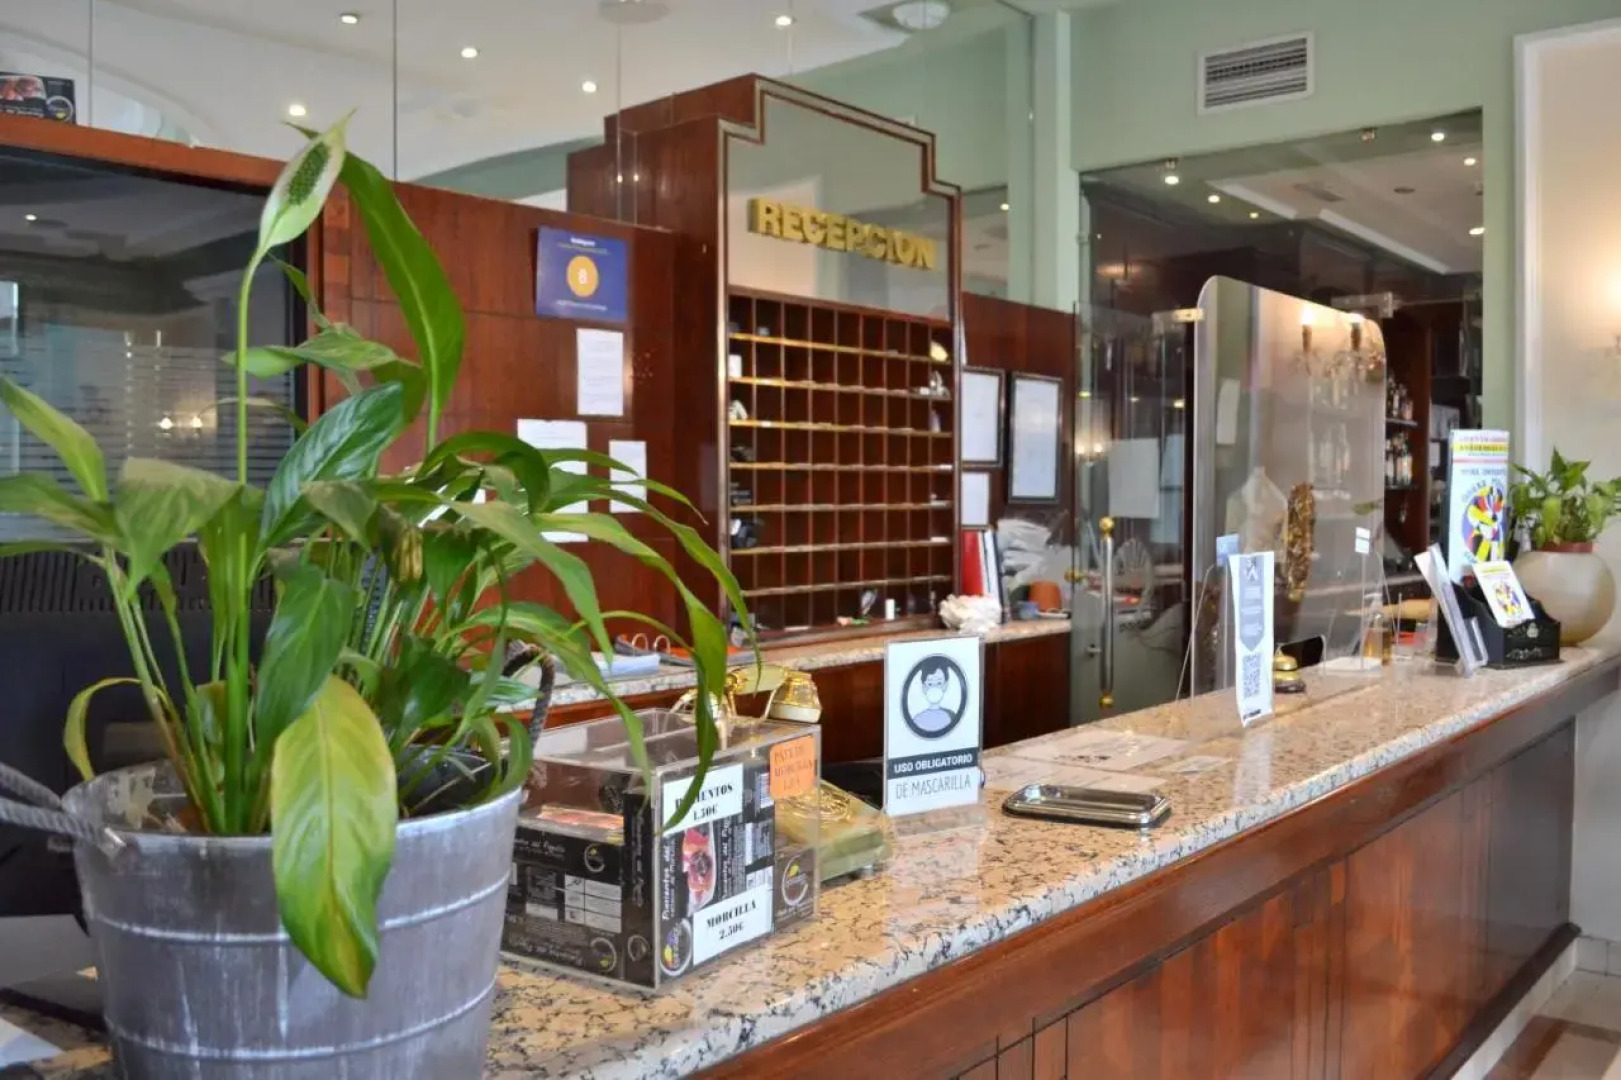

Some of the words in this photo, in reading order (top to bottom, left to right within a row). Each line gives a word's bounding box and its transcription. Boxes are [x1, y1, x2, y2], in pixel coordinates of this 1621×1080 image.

[894, 762, 913, 773] USO
[915, 753, 973, 770] OBLIGATORIO
[896, 781, 909, 800] DE
[911, 774, 972, 796] MASCARILLA
[706, 899, 757, 928] MORCILLA
